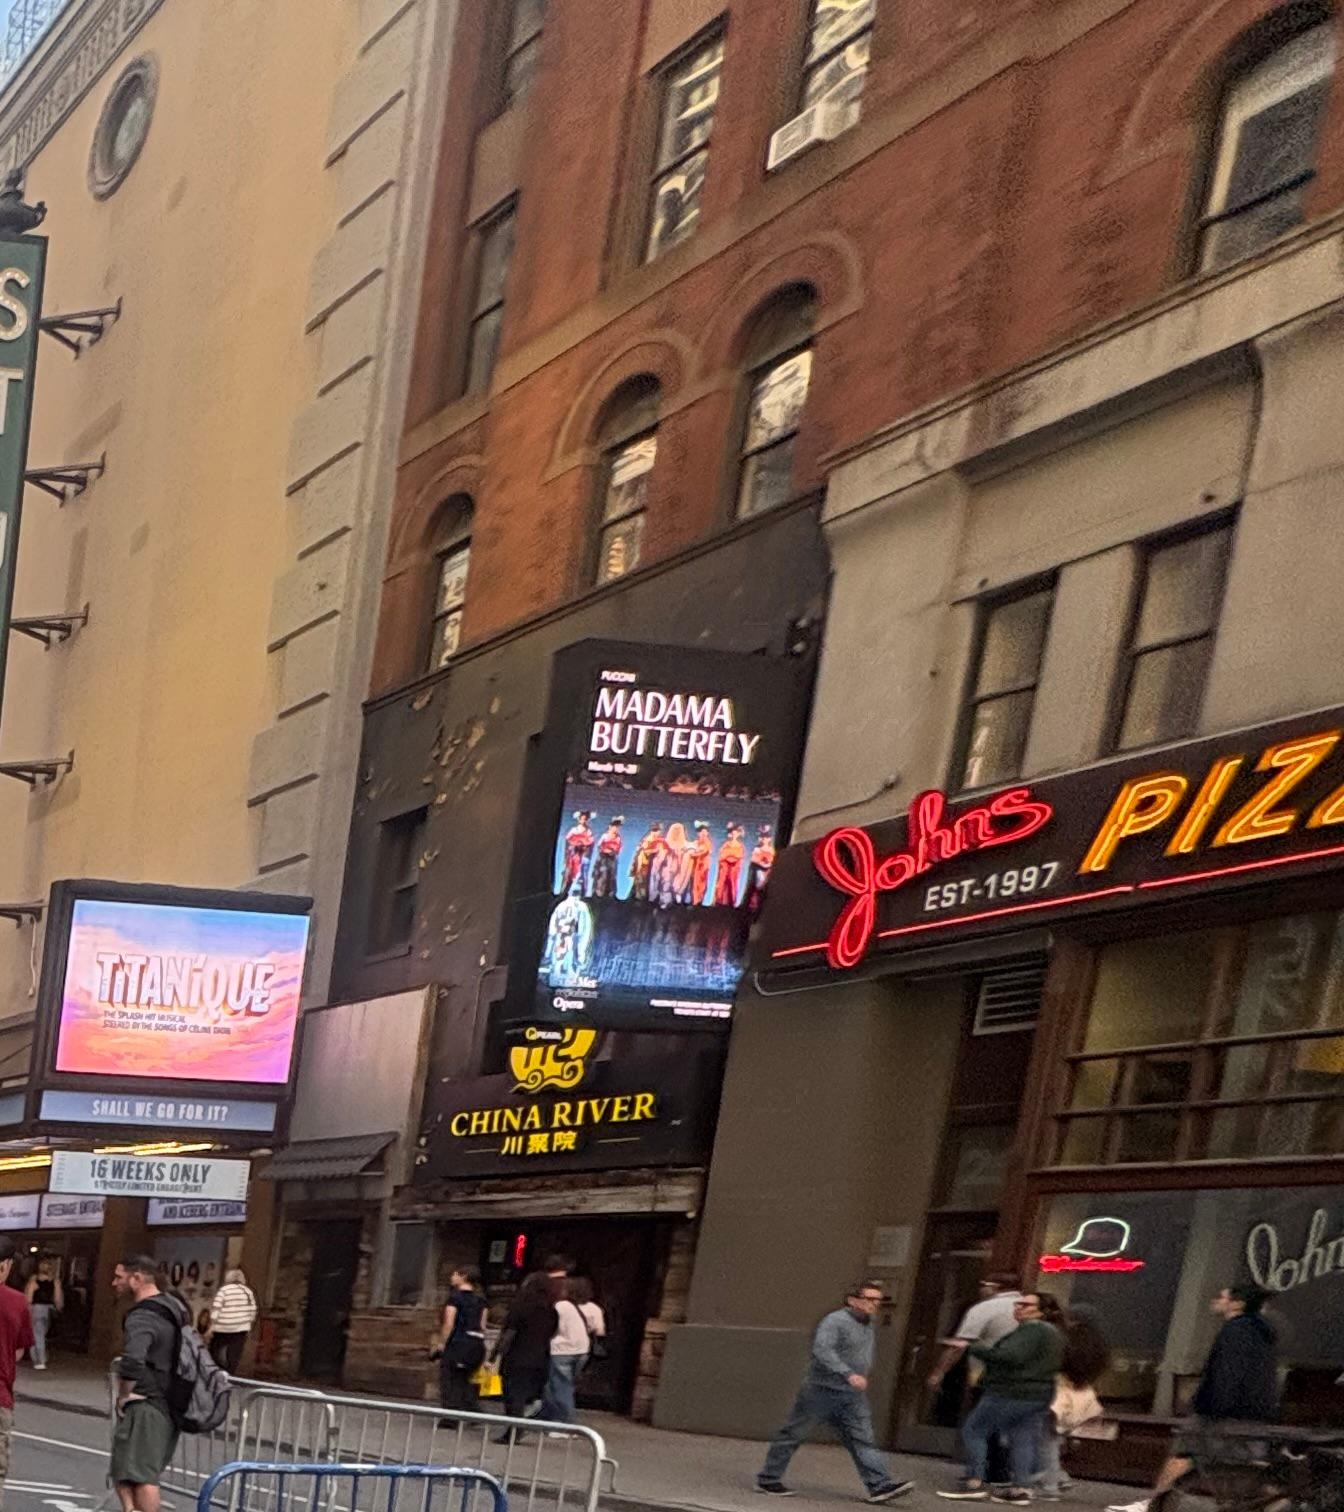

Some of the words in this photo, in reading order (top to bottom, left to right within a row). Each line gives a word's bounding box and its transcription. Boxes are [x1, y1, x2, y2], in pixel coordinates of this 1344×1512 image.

[594, 686, 733, 730] MADAMA
[589, 720, 760, 765] BUTTERFLY
[922, 861, 1060, 912] EST-1997
[104, 1010, 115, 1018] THE
[118, 1011, 143, 1020] SPLASH
[145, 1012, 156, 1021] HIT
[157, 1014, 186, 1023] MUSICAL
[132, 1021, 140, 1030] BY
[141, 1022, 153, 1031] THE
[154, 1023, 177, 1032] SONGS
[178, 1024, 187, 1033] OF
[92, 1099, 131, 1116] SHALL
[135, 1101, 154, 1118] WE
[156, 1103, 175, 1119] GO
[178, 1104, 204, 1121] FOR
[207, 1105, 229, 1122] IT?
[450, 1104, 542, 1137] CHINA
[550, 1092, 656, 1129] RIVER
[90, 1159, 109, 1179] 16
[110, 1159, 166, 1182] WEEKS
[171, 1162, 212, 1185] ONLY
[163, 1206, 177, 1219] AND
